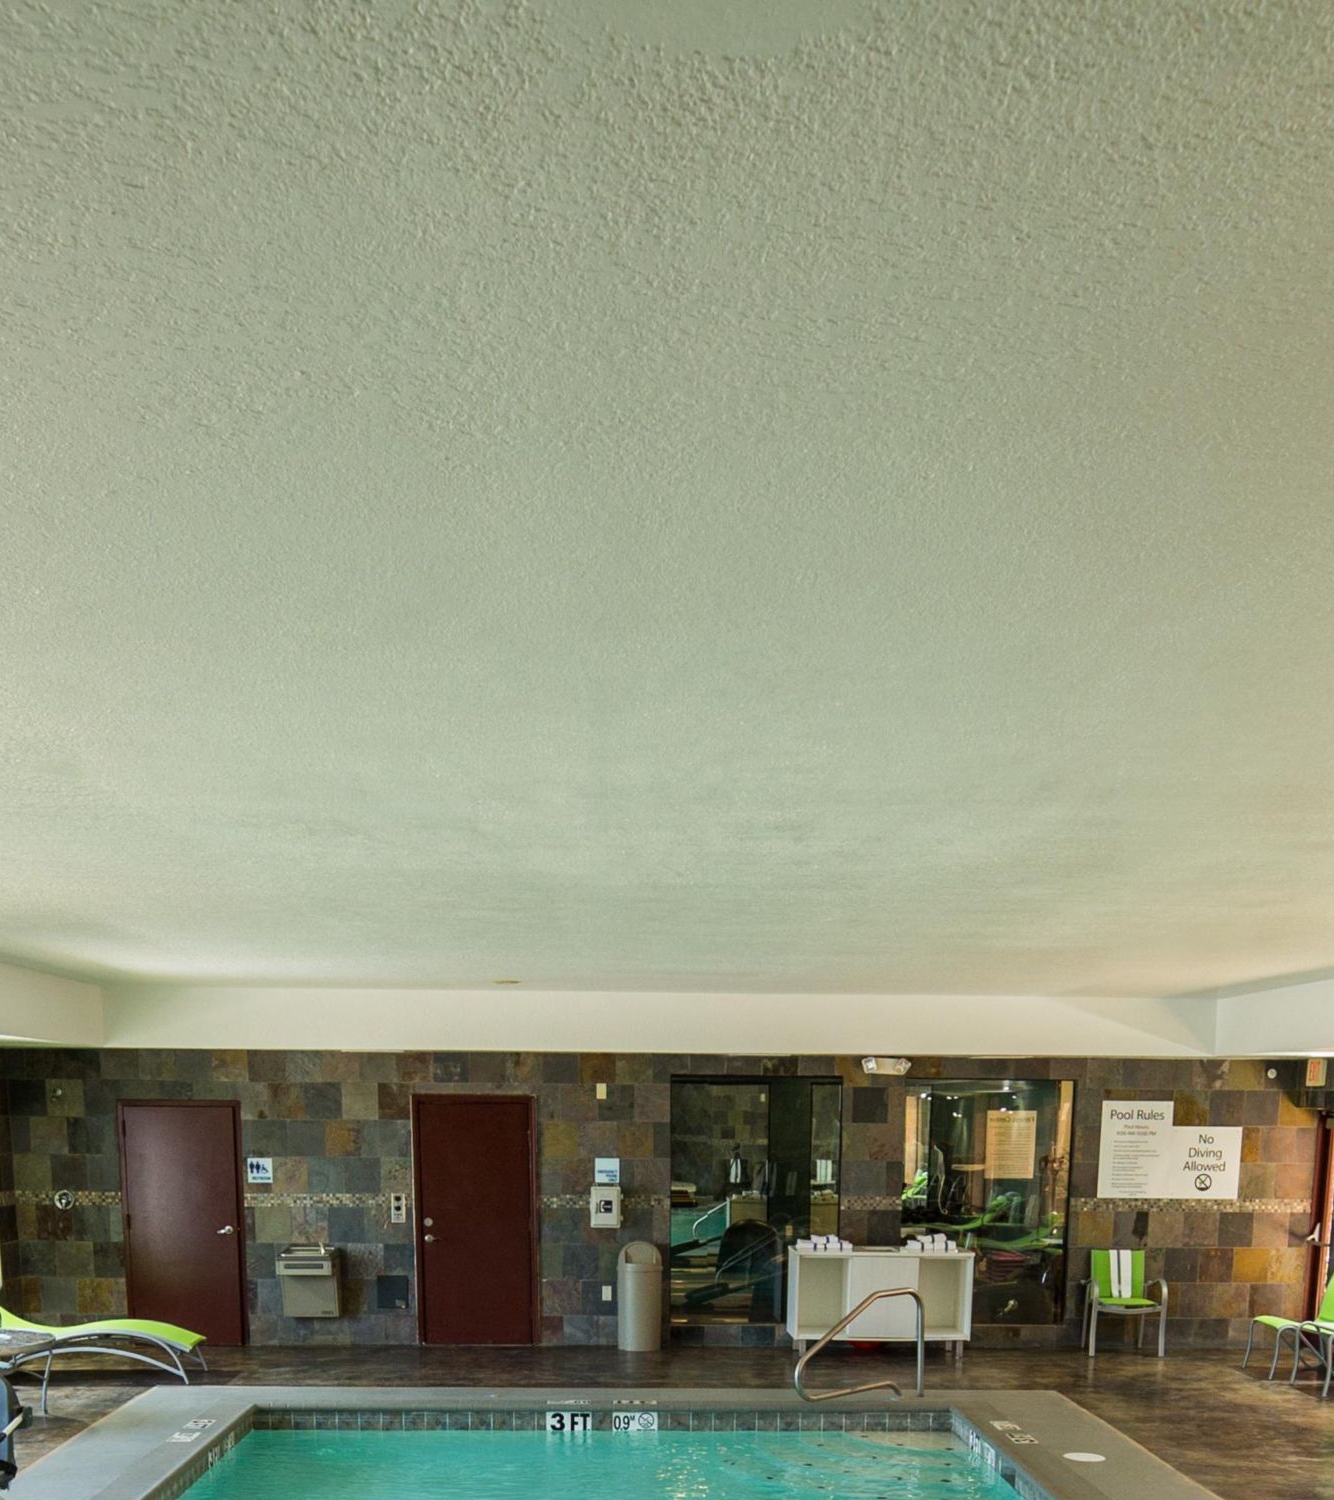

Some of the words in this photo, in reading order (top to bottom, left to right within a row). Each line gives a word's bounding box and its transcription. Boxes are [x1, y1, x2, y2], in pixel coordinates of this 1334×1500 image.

[1110, 1109, 1134, 1120] Pool
[1136, 1109, 1165, 1120] Rules
[1198, 1134, 1214, 1145] No
[1188, 1147, 1223, 1161] Diving
[1183, 1161, 1226, 1172] Allowed
[550, 1413, 565, 1431] 3
